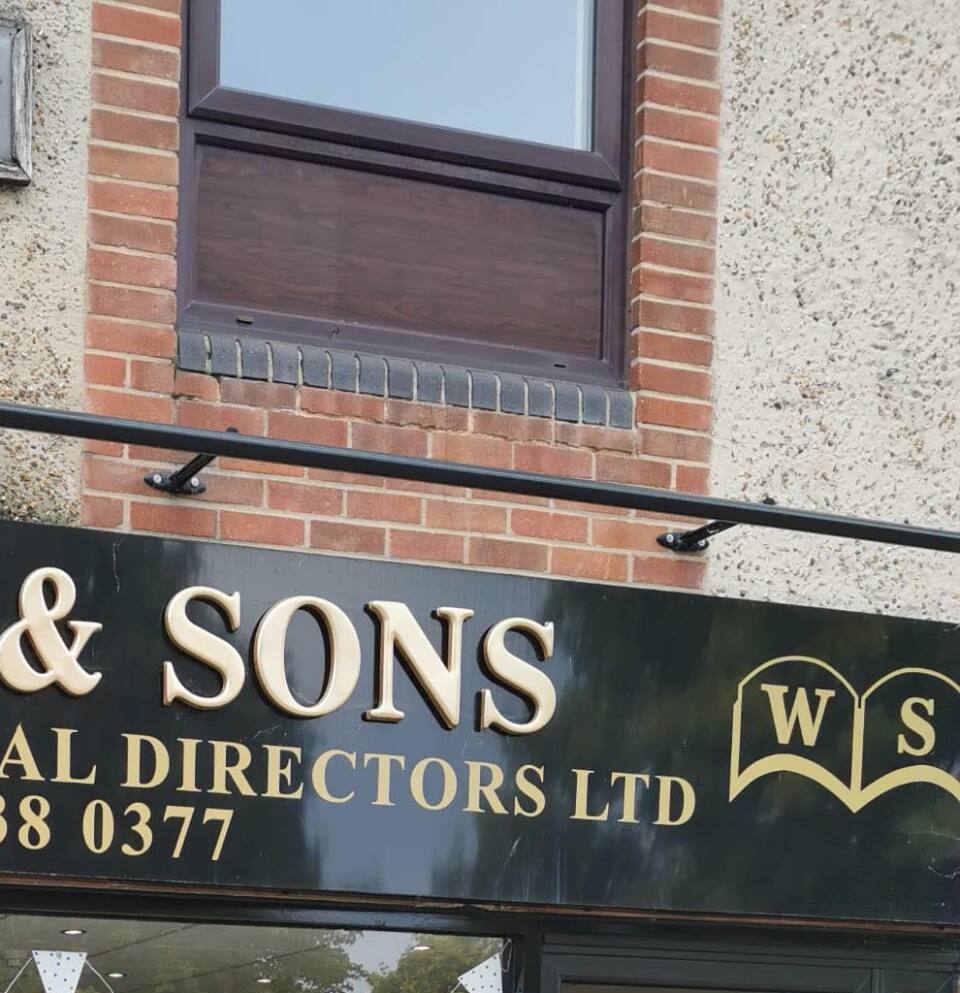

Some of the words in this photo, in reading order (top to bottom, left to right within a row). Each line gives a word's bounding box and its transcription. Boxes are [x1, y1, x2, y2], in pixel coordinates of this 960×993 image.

[162, 584, 558, 735] SONS
[760, 683, 837, 747] W
[897, 697, 937, 757] S
[125, 733, 547, 818] DIRECTORS
[571, 768, 697, 826] LTD
[82, 799, 235, 862] 0377
